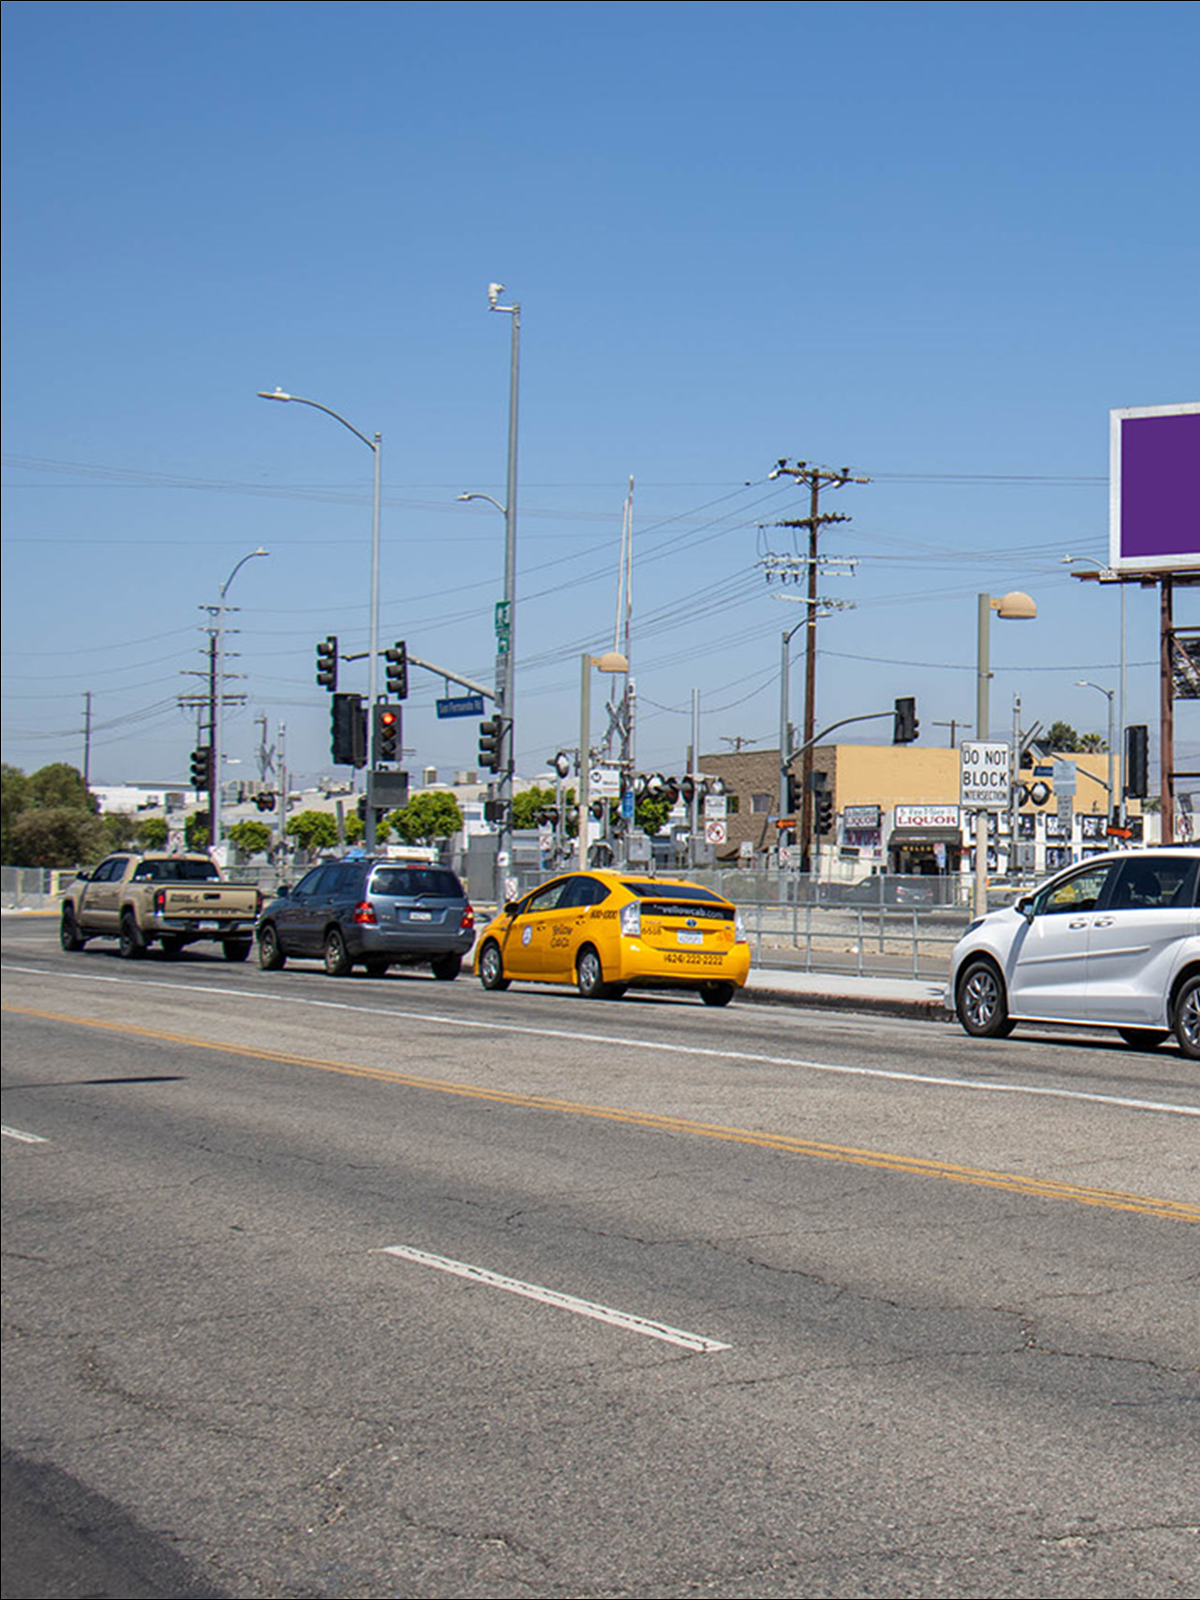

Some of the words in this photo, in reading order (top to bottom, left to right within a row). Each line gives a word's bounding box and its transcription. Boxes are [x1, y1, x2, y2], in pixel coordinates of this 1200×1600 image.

[963, 750, 979, 764] DO
[985, 750, 1007, 765] NOT
[963, 771, 1008, 786] BLOCK
[964, 790, 1008, 801] INTERSECTION
[898, 815, 957, 826] LIQUOR
